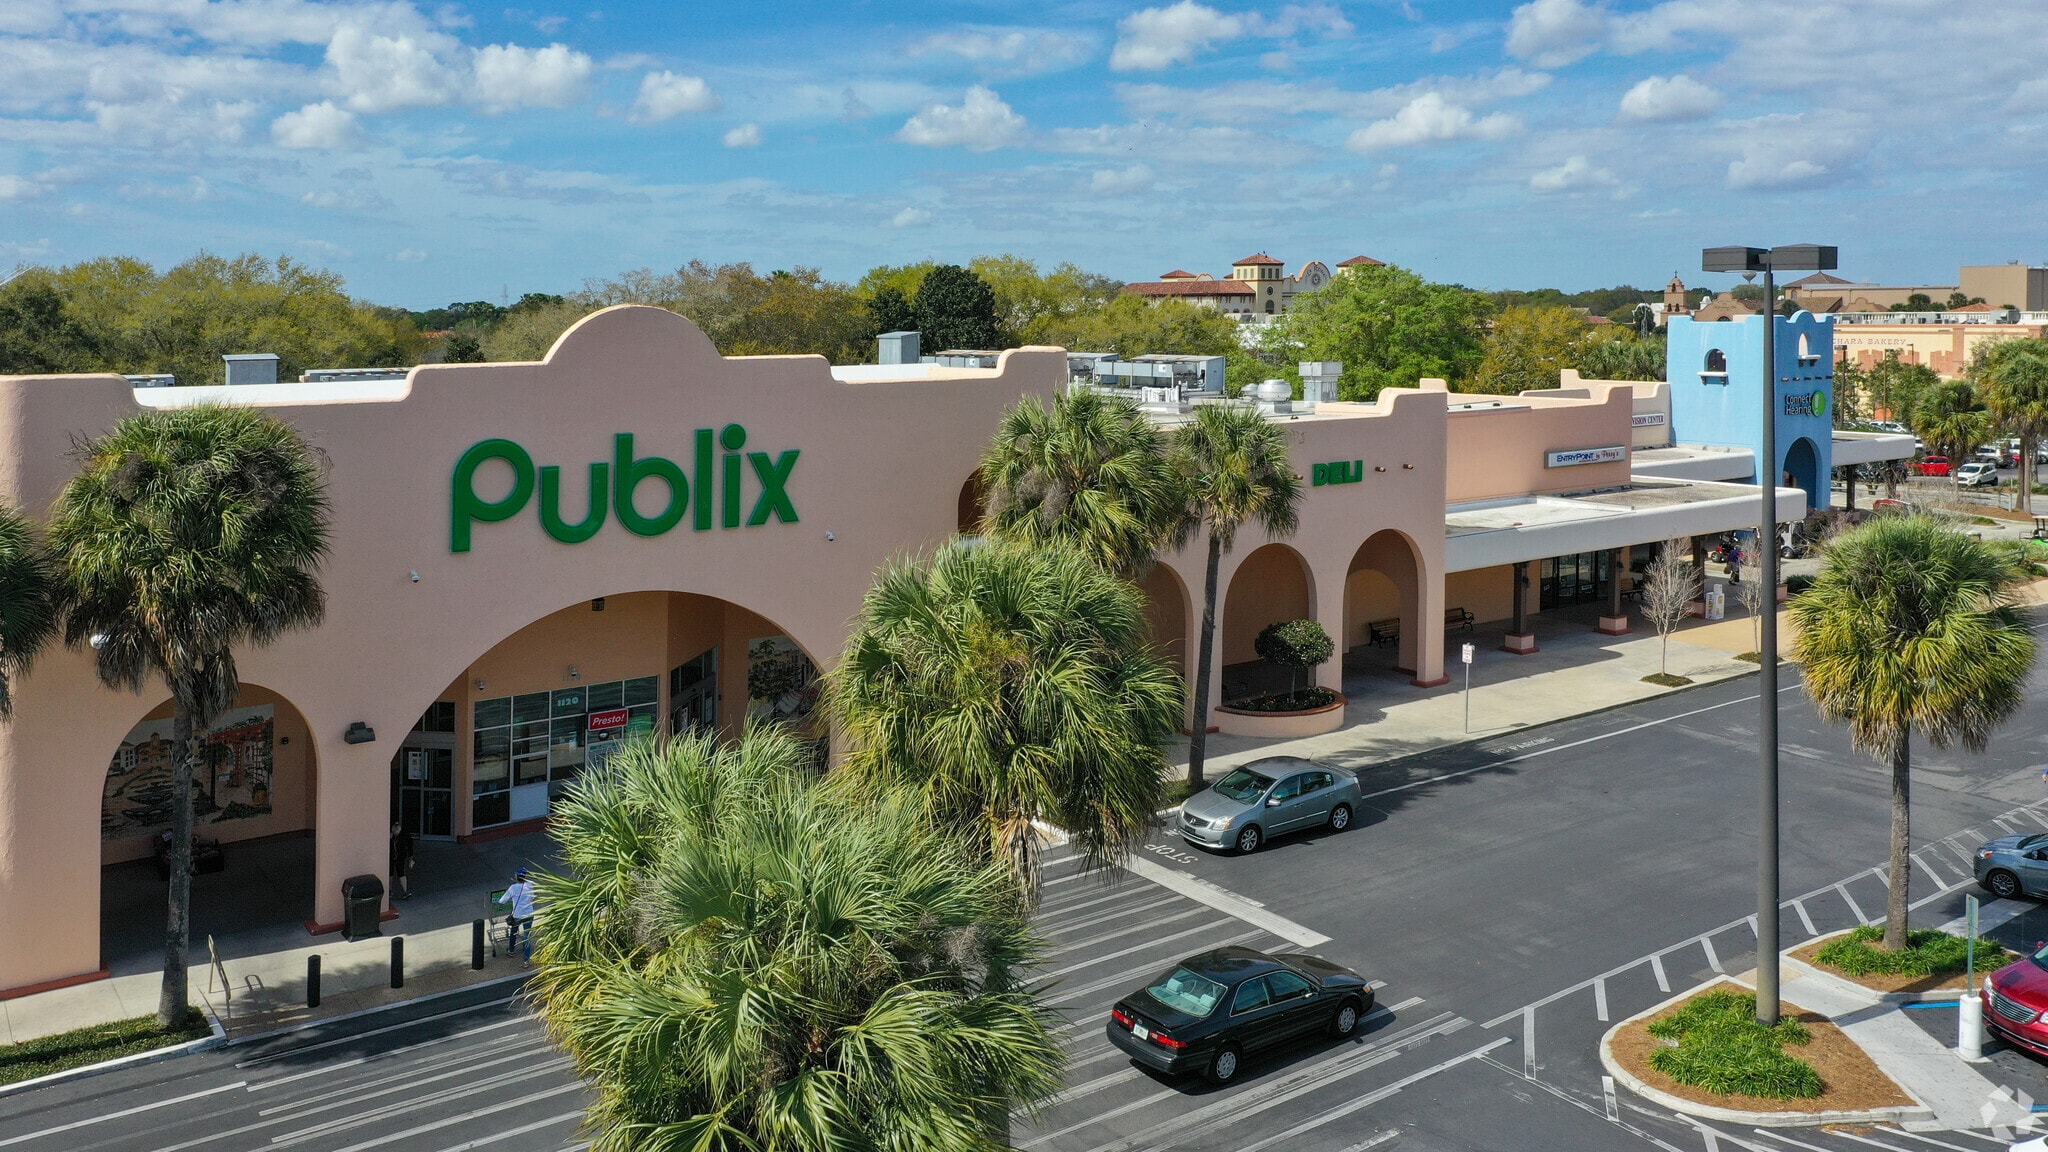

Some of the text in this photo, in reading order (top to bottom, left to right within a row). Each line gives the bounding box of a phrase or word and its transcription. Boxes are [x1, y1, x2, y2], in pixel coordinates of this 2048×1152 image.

[1785, 394, 1812, 405] Connect
[1785, 405, 1812, 416] Hearing
[1648, 415, 1664, 424] CENTER
[1312, 460, 1363, 487] DELI
[450, 423, 800, 554] Publix
[557, 696, 580, 707] 1120
[592, 713, 625, 726] Presto!
[1143, 844, 1199, 864] STOP
